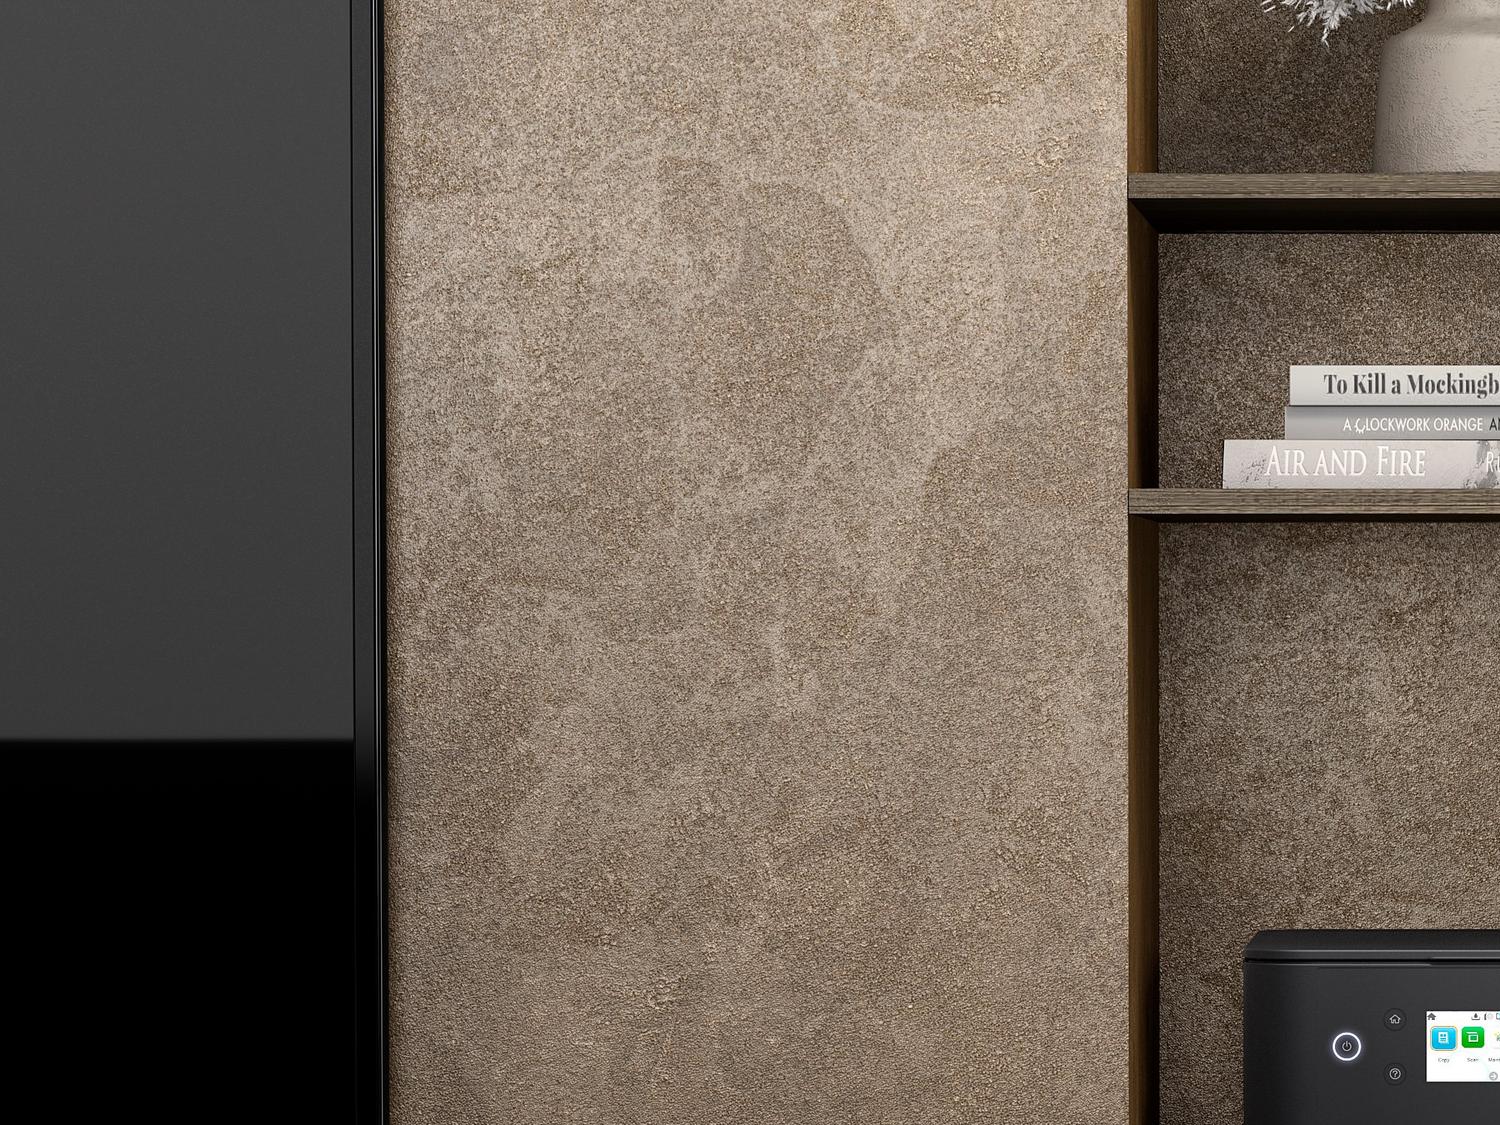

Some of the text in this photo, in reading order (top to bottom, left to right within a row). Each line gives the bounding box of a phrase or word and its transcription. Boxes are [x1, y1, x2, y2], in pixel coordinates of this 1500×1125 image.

[1323, 374, 1348, 394] To
[1352, 372, 1386, 394] Kill
[1391, 380, 1401, 394] a
[1343, 419, 1351, 431] A
[1354, 417, 1430, 434] CLOCKWORK
[1433, 418, 1483, 431] ORANGE
